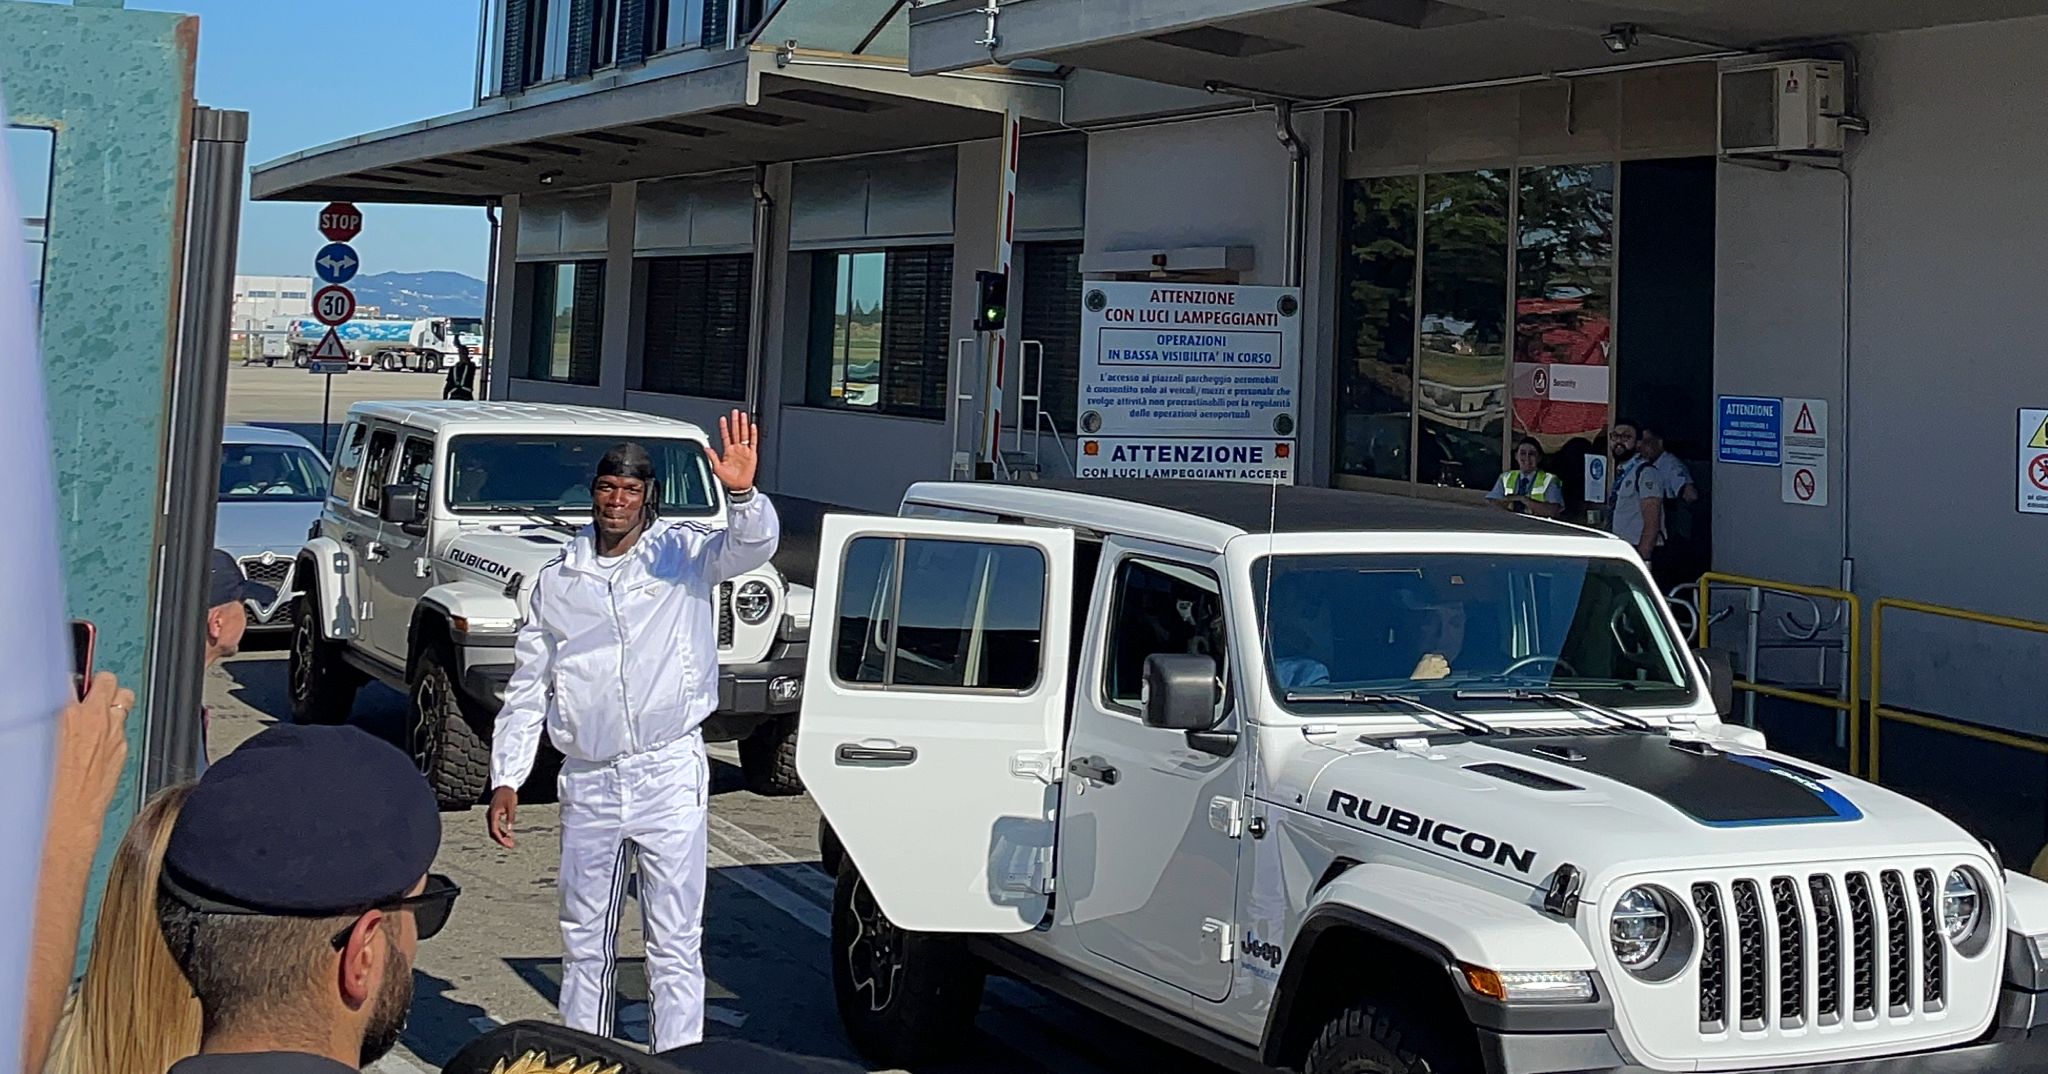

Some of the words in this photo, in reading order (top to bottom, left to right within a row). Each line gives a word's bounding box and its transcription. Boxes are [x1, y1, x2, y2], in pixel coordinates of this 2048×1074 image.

[321, 213, 360, 231] STOP
[1150, 289, 1235, 305] ATTENZIONE
[323, 295, 346, 317] 30
[1105, 308, 1134, 322] CON
[1140, 309, 1169, 323] LUCI
[1174, 310, 1278, 327] LAMPEGGIANTI
[1157, 335, 1226, 347] OPERAZIONI
[1108, 349, 1120, 359] IN
[1123, 350, 1158, 361] BASSA
[1162, 351, 1219, 362] VISIBILITA'
[1223, 352, 1234, 362] IN
[1238, 353, 1271, 364] CORSO
[1100, 373, 1140, 382] L'accesso
[1141, 373, 1149, 382] ai
[1151, 374, 1183, 384] piazzali
[1185, 374, 1232, 385] parcheggio
[1234, 375, 1279, 384] aeromobili
[1086, 384, 1092, 393] è
[1093, 385, 1138, 394] consentito
[1140, 385, 1157, 394] solo
[1159, 385, 1167, 394] ai
[1234, 386, 1274, 397] personale
[1276, 387, 1291, 396] che
[1087, 396, 1115, 408] svolge
[1117, 397, 1147, 406] attività
[1148, 398, 1165, 406] non
[1166, 397, 1225, 407] procrastinabili
[1226, 399, 1239, 408] per
[1241, 398, 1249, 407] la
[1250, 398, 1291, 410] regolarità
[1726, 403, 1774, 417] ATTENZIONE
[1129, 408, 1150, 418] delle
[1153, 408, 1198, 419] operazioni
[1199, 409, 1251, 420] aeroportuali
[1111, 445, 1263, 464] ATTENZIONE
[1082, 468, 1108, 478] CON
[1113, 468, 1141, 478] LUCI
[1145, 468, 1236, 479] LAMPEGGIANTI
[1240, 469, 1287, 479] ACCESE
[449, 548, 512, 579] RUBICON
[1326, 789, 1538, 874] RUBICON
[1241, 930, 1282, 969] Jeep
